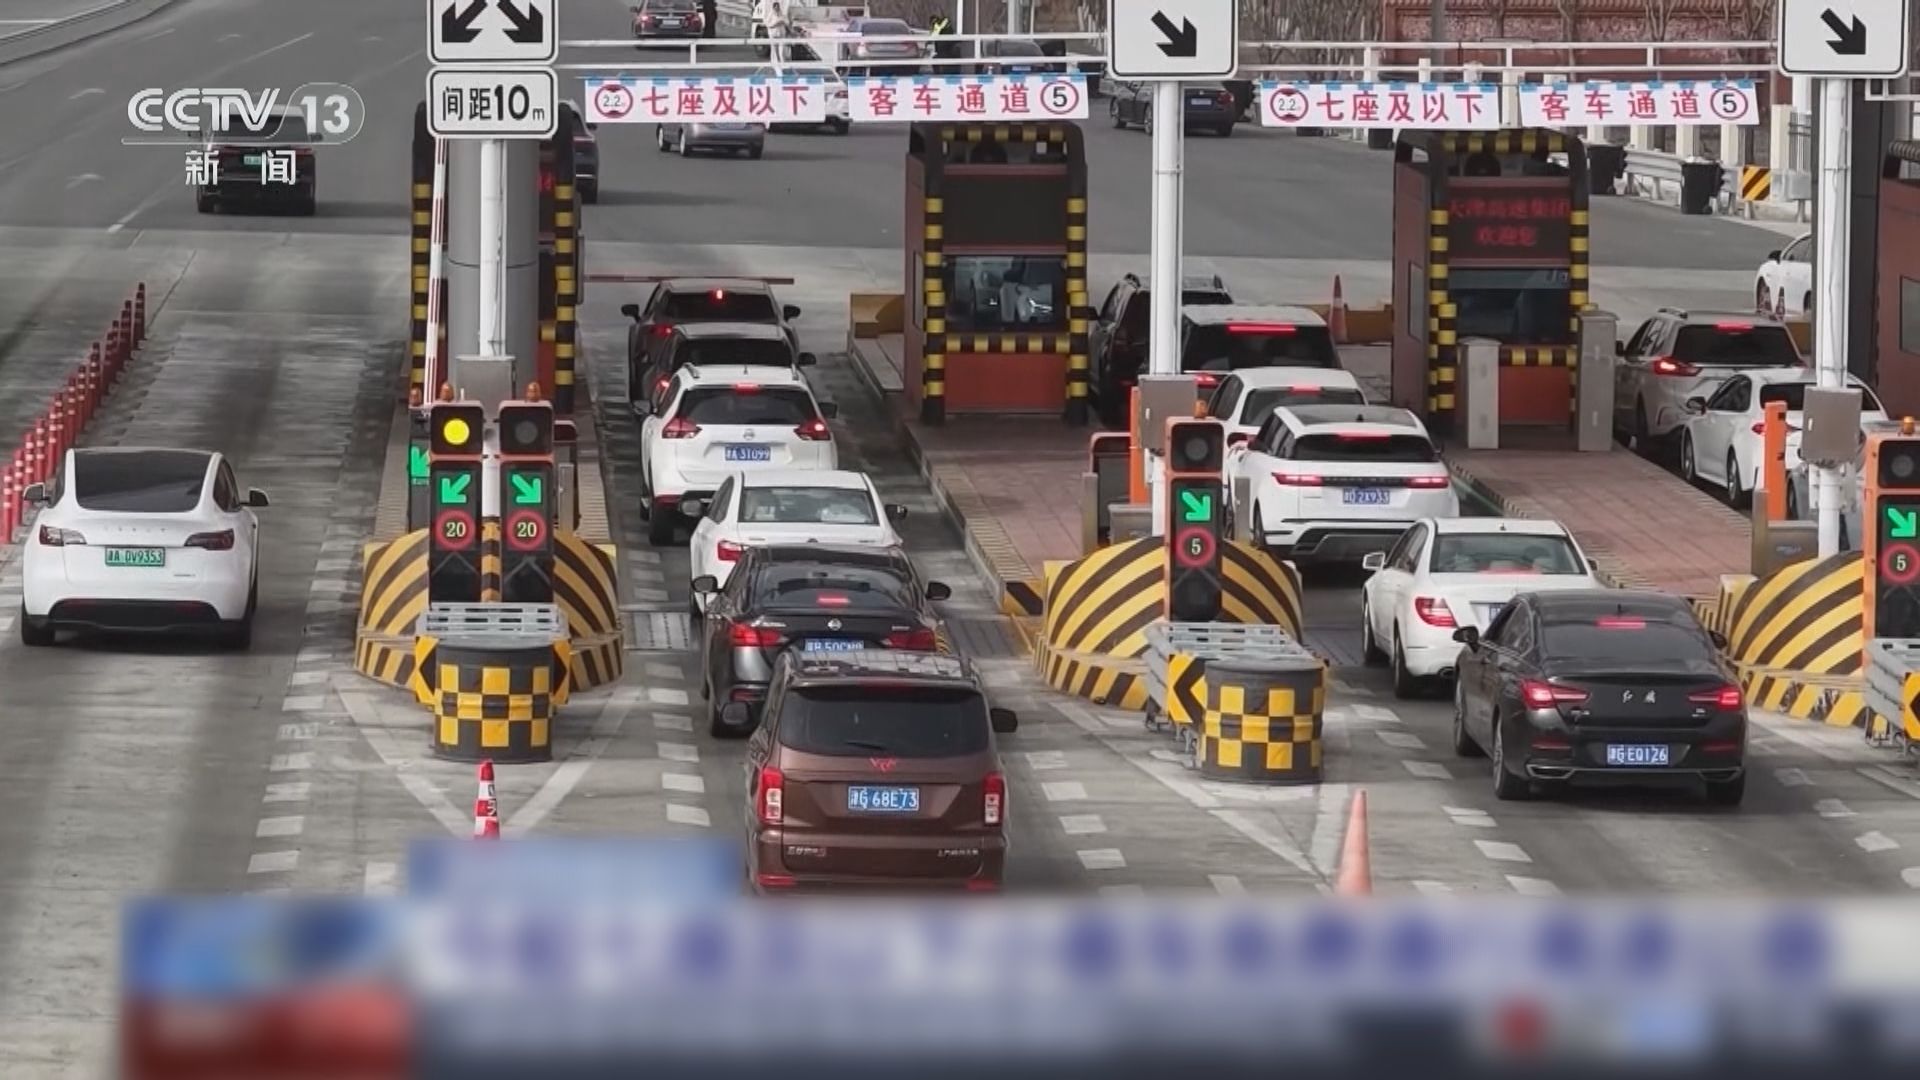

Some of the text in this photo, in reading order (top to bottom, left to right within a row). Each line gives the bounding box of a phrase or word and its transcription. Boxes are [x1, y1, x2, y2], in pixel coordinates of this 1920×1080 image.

[442, 85, 545, 121] 间距10m
[641, 86, 809, 117] 七座及以下
[868, 84, 1030, 116] 客车通道
[1316, 92, 1484, 123] 七座及以下
[1540, 90, 1701, 121] 客车通道
[445, 522, 467, 538] 20
[516, 522, 538, 538] 20
[1190, 537, 1202, 556] 5
[1895, 553, 1908, 572] 5
